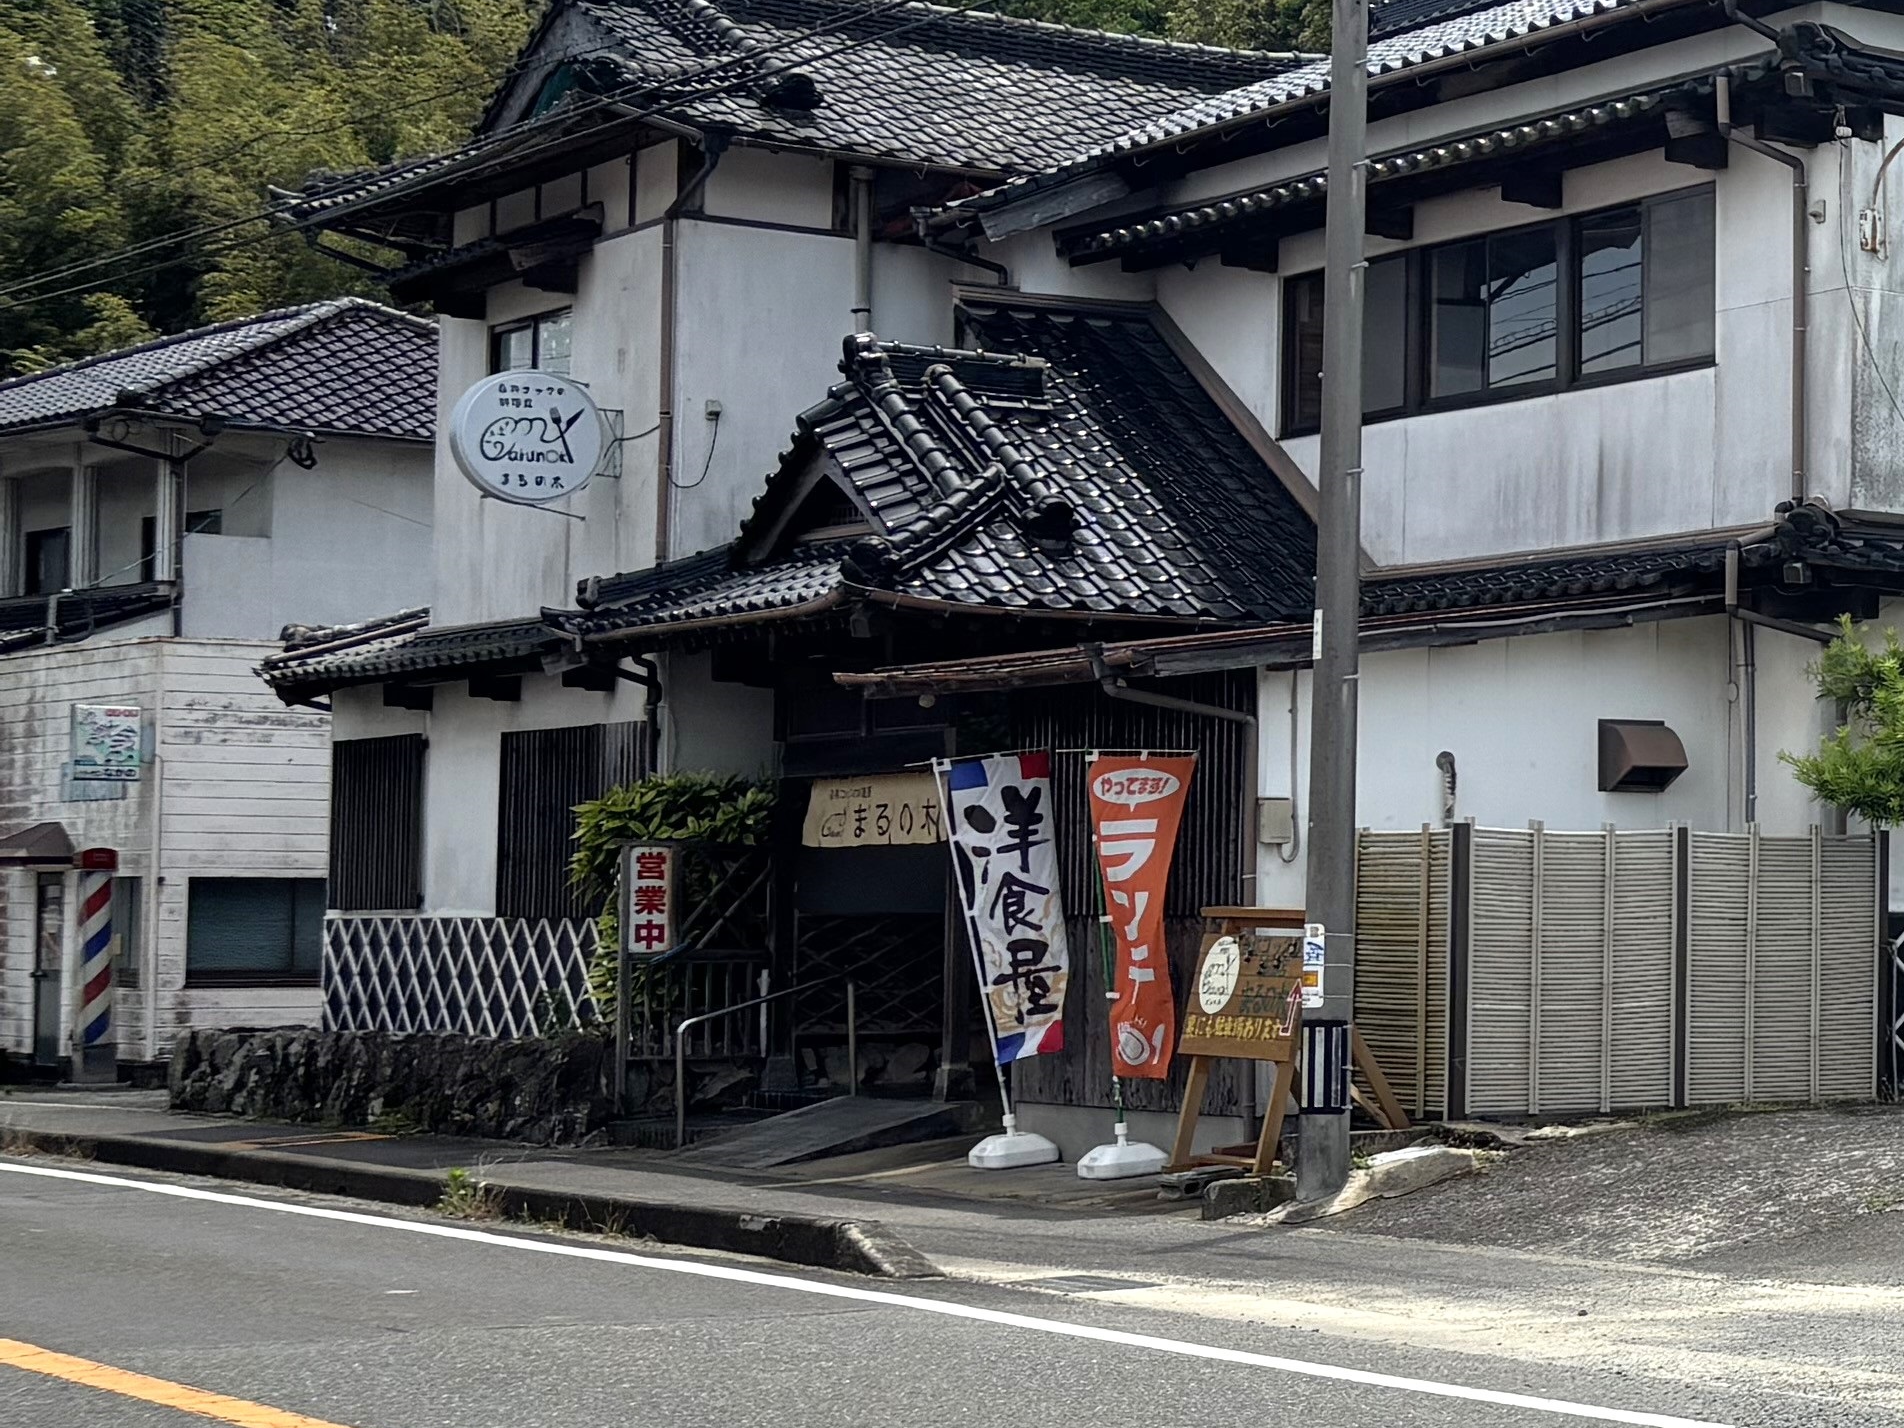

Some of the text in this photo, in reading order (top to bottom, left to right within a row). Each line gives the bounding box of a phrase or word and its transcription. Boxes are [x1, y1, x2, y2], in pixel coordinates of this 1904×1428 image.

[853, 798, 939, 839] まるの木
[634, 852, 667, 950] 営業中
[964, 785, 1062, 1025] 洋食屋
